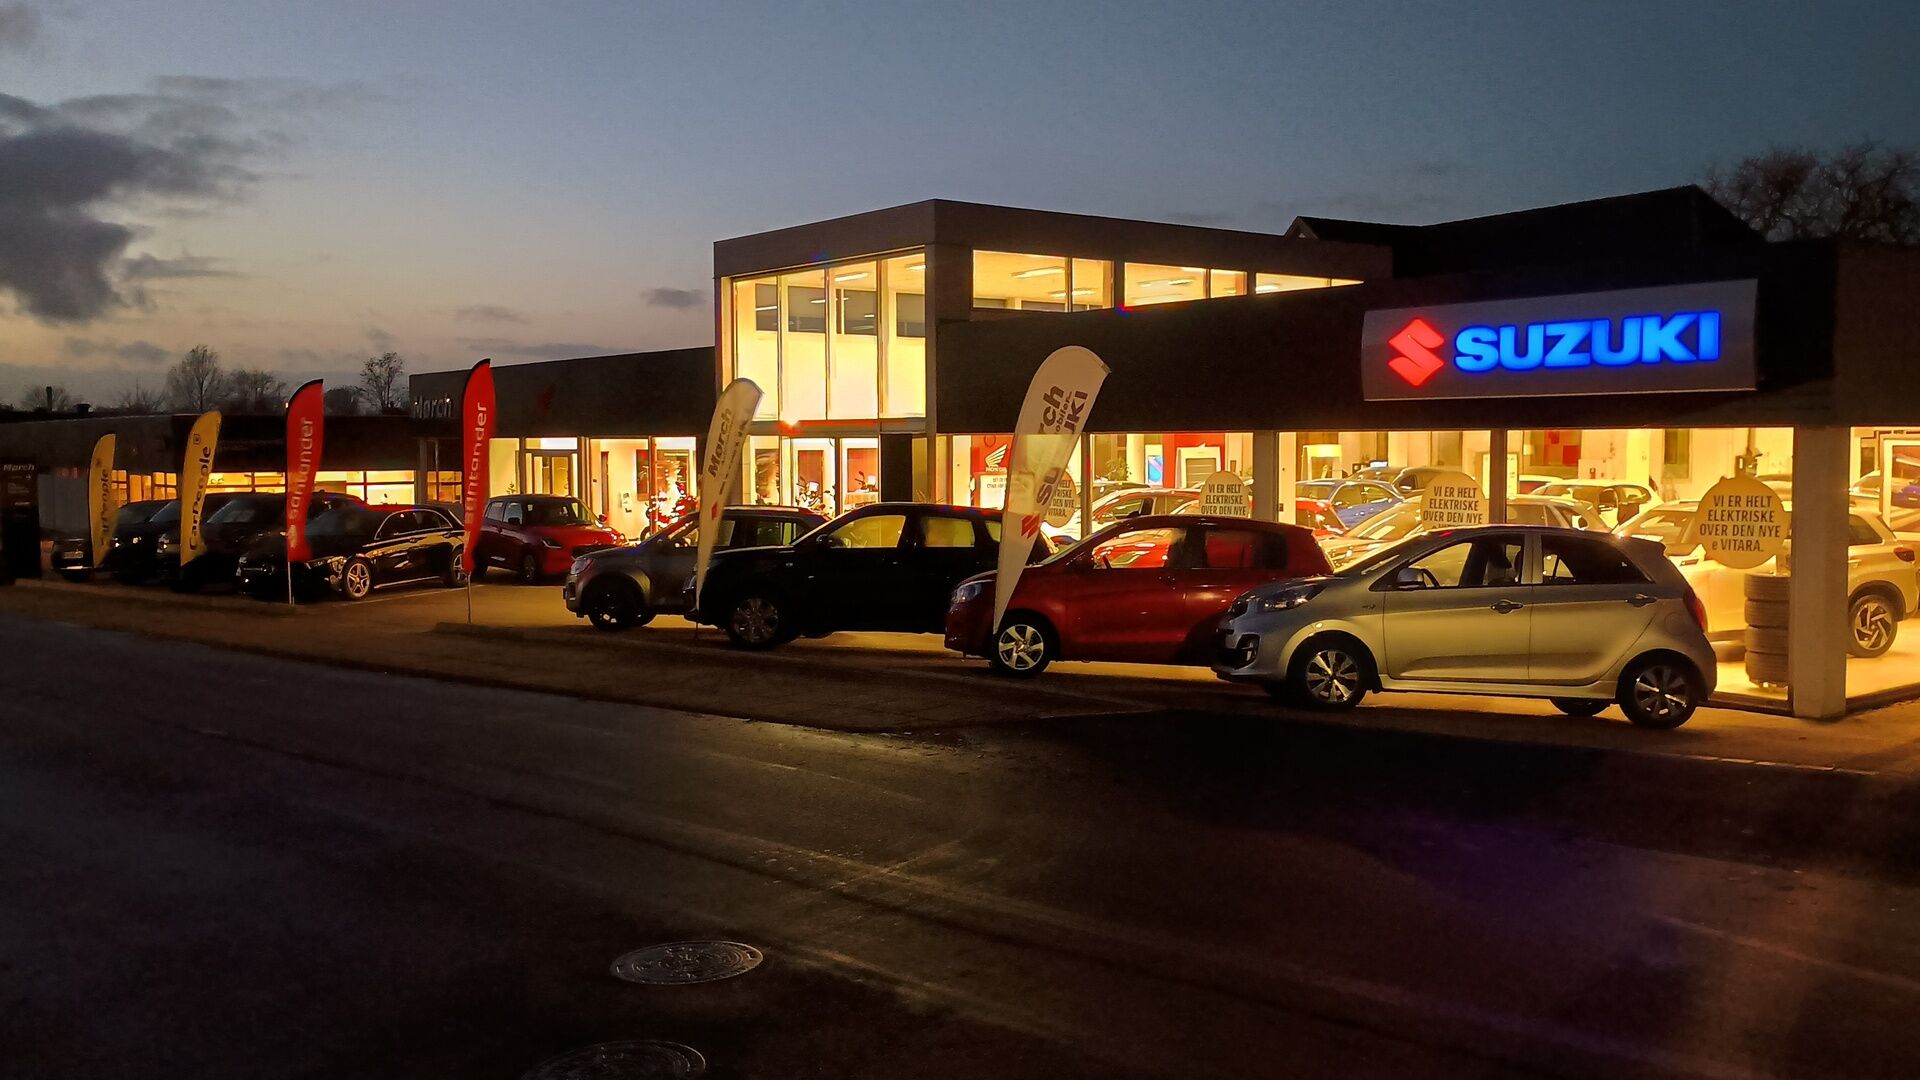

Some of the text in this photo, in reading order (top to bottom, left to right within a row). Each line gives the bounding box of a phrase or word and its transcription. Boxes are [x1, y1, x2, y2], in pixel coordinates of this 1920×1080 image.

[1454, 311, 1720, 372] SUZUKI
[1208, 484, 1241, 493] VI ER HELT
[1433, 486, 1477, 498] VI ER HELT
[1205, 495, 1243, 504] ELEKTRISKE
[1429, 498, 1479, 511] ELEKTRISKE
[1713, 495, 1772, 508] VI ER HELT
[1201, 505, 1246, 516] OVER DEN NYE
[1423, 510, 1483, 524] OVER DEN NYE
[1708, 509, 1775, 523] ELEKTRISKE
[1699, 523, 1781, 538] OVER DEN NYE
